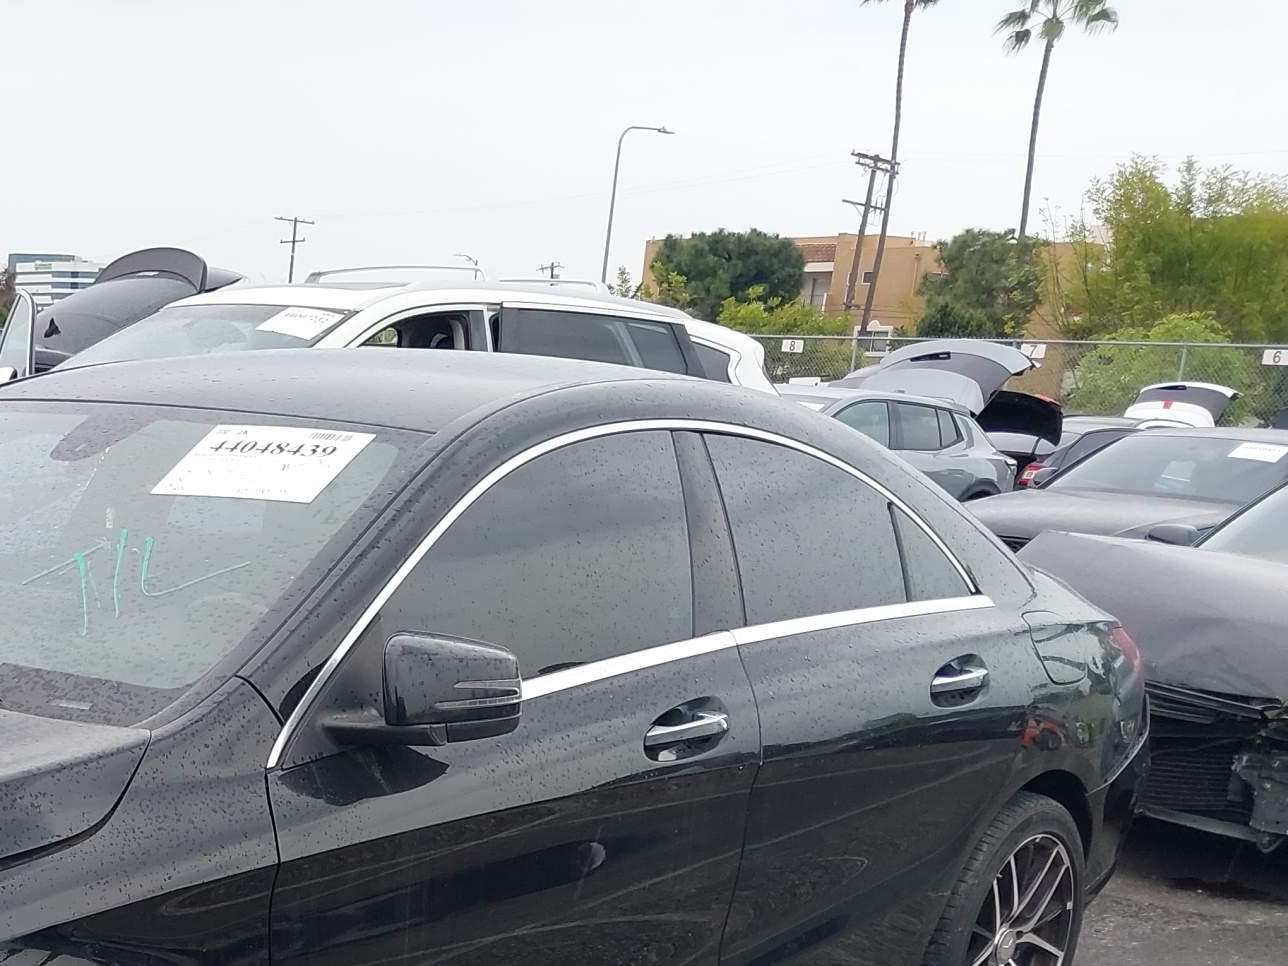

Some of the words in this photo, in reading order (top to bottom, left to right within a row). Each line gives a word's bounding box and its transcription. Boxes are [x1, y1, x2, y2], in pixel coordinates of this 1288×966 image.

[789, 340, 796, 352] 8
[1030, 344, 1038, 357] 7
[1272, 350, 1282, 364] 6
[209, 439, 338, 457] 44048439
